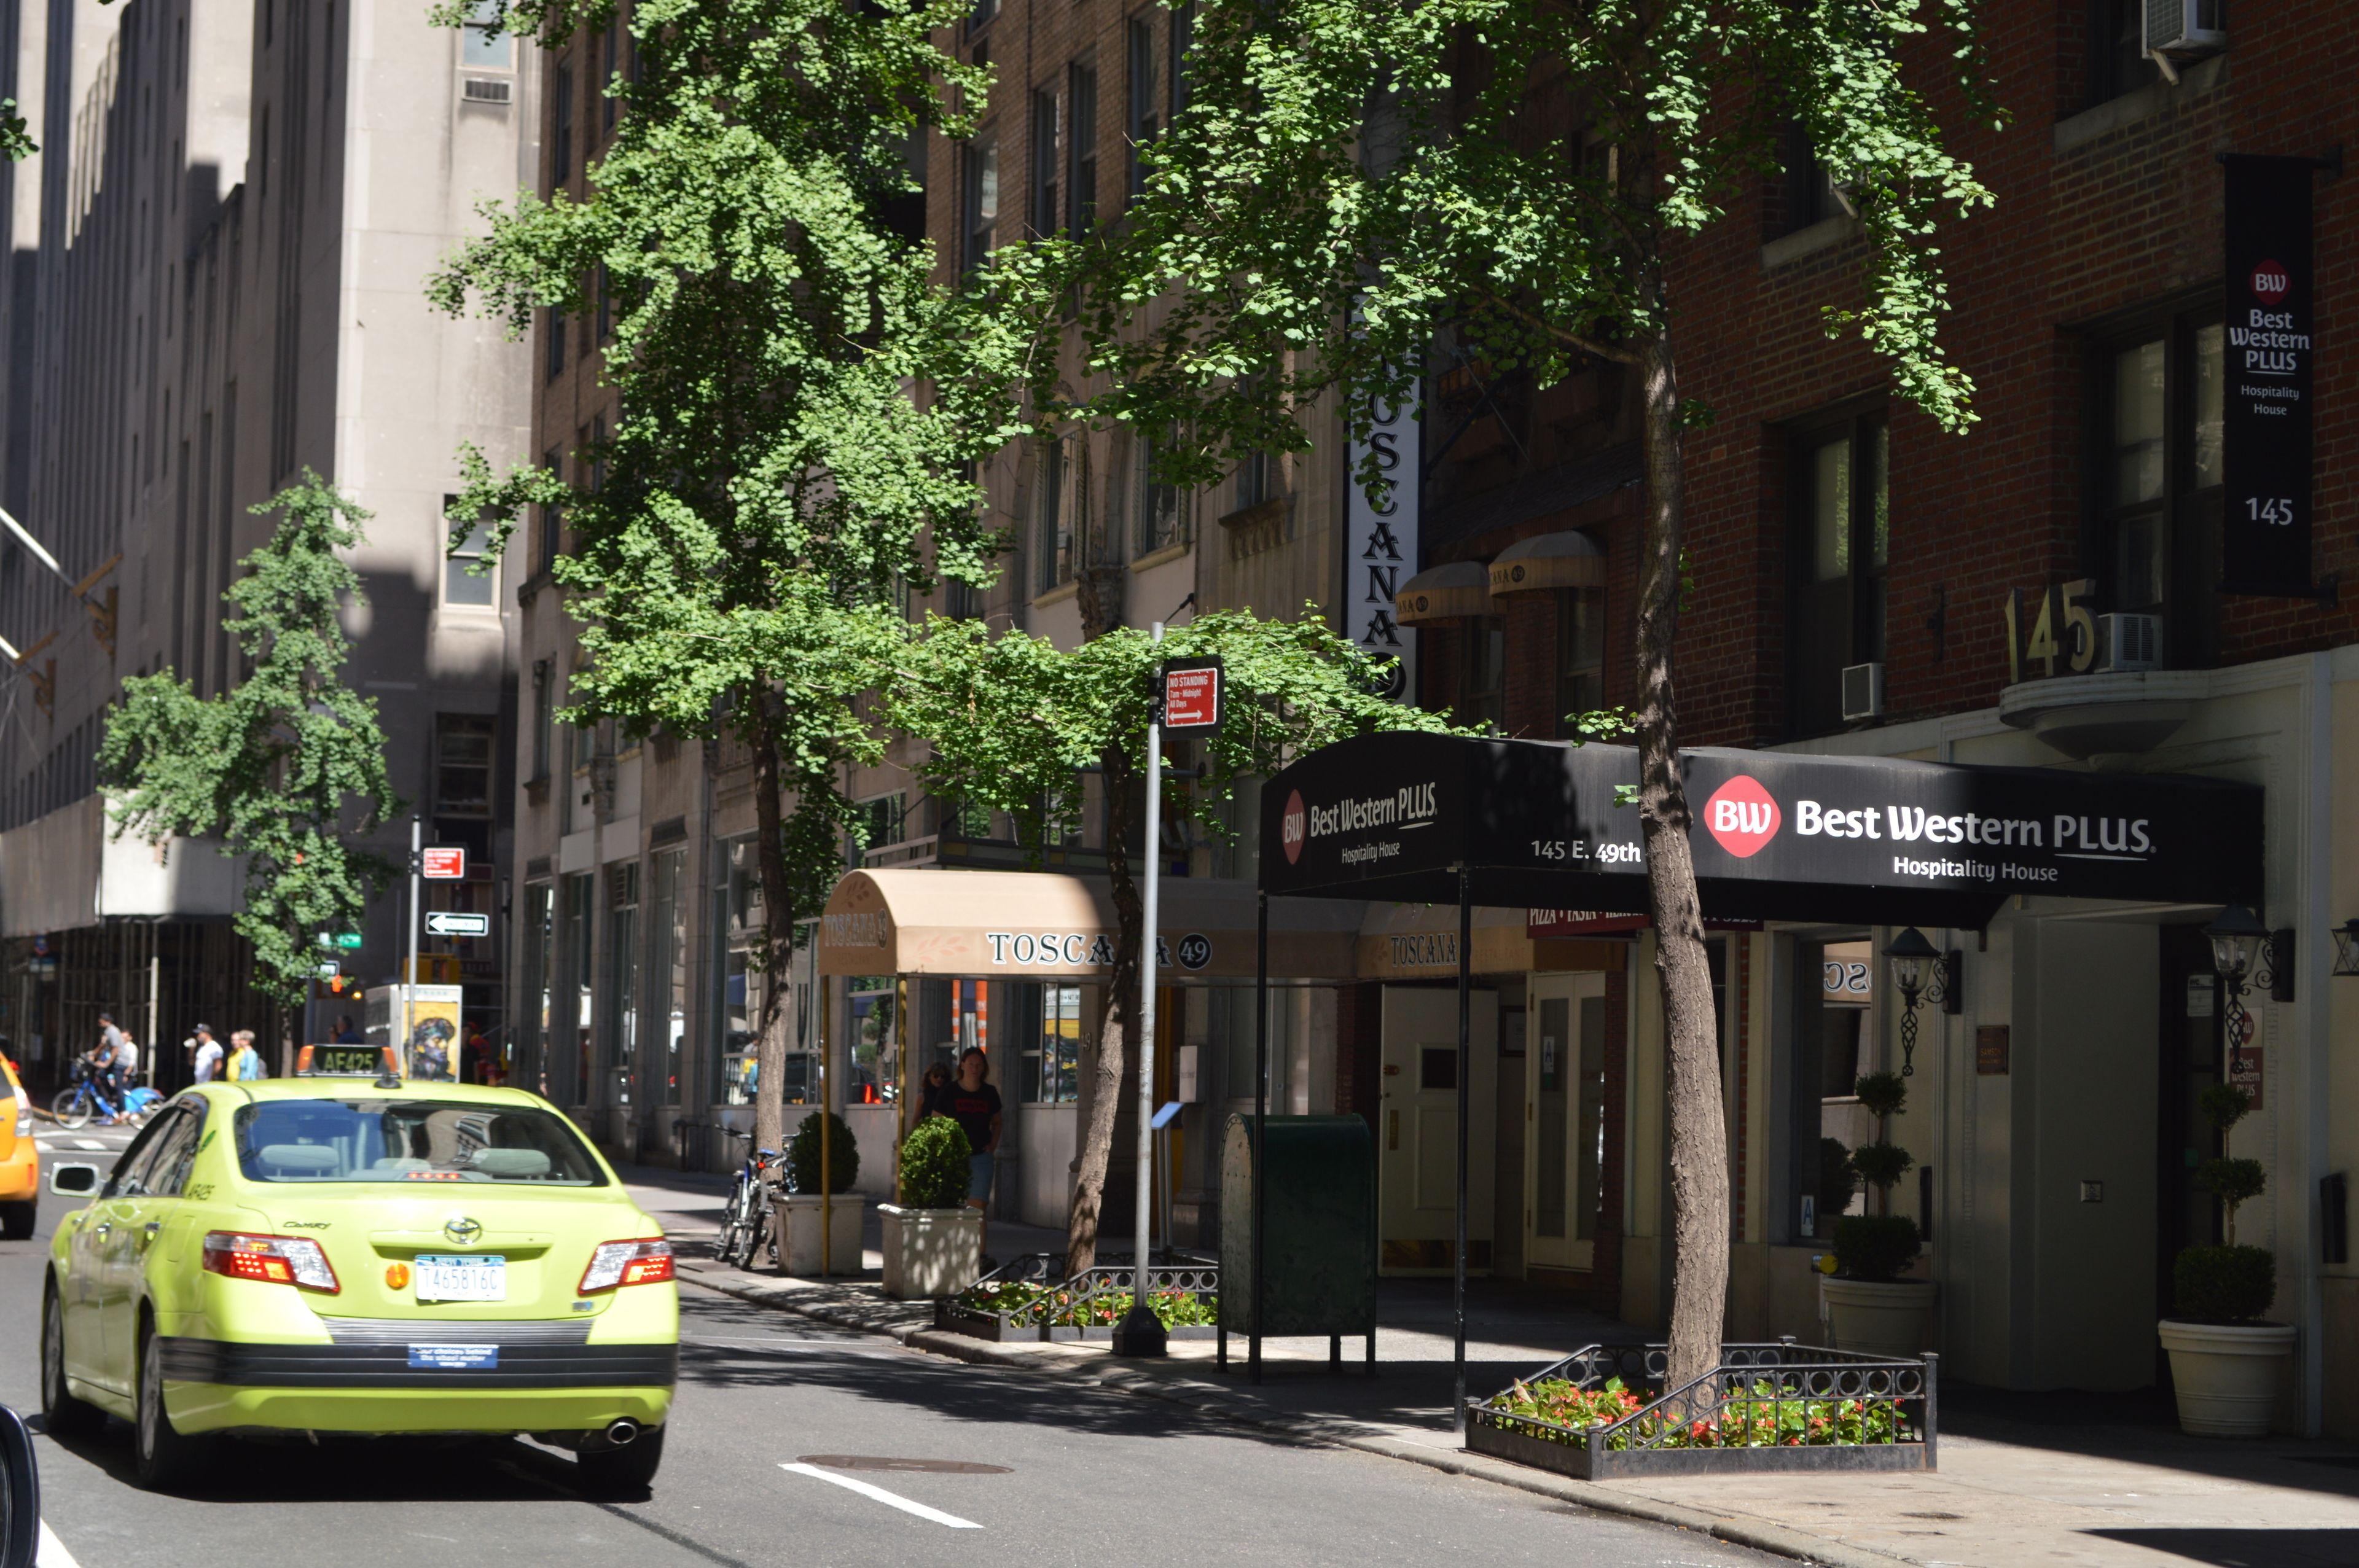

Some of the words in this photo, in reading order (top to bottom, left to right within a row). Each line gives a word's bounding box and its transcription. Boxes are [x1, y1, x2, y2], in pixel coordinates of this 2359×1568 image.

[2255, 273, 2286, 292] BW
[2249, 308, 2293, 330] Best
[2229, 327, 2310, 350] Western
[2245, 351, 2297, 371] PLUS
[2241, 384, 2299, 400] Hospitality
[2253, 403, 2287, 416] House
[2245, 497, 2293, 526] 145
[2005, 579, 2102, 684] 145
[1170, 677, 1179, 687] NO
[1180, 676, 1208, 687] STANDING
[1183, 688, 1202, 698] Midnight
[1176, 700, 1187, 709] Days
[1284, 813, 1304, 844] BW
[1310, 805, 1339, 838] Best
[1340, 797, 1395, 832] Western
[1398, 781, 1436, 819] PLUS
[1715, 800, 1772, 835] BW
[1796, 800, 1881, 840] Best
[1886, 805, 2043, 848] Western
[2054, 814, 2150, 854] PLUS
[1342, 844, 1377, 865] Hospitality
[1379, 840, 1400, 857] House
[1532, 840, 1565, 860] 145
[1572, 840, 1590, 860] E.
[1595, 841, 1641, 863] 49th
[1893, 856, 1995, 883] Hospitality
[2001, 862, 2059, 882] House
[1530, 908, 1557, 926] PIZZA
[987, 933, 1173, 967] TOSCAA
[1391, 933, 1457, 968] TOSCANA
[324, 1051, 374, 1073] AF425
[1803, 1198, 1813, 1225] A
[423, 1268, 498, 1290] T465816C
